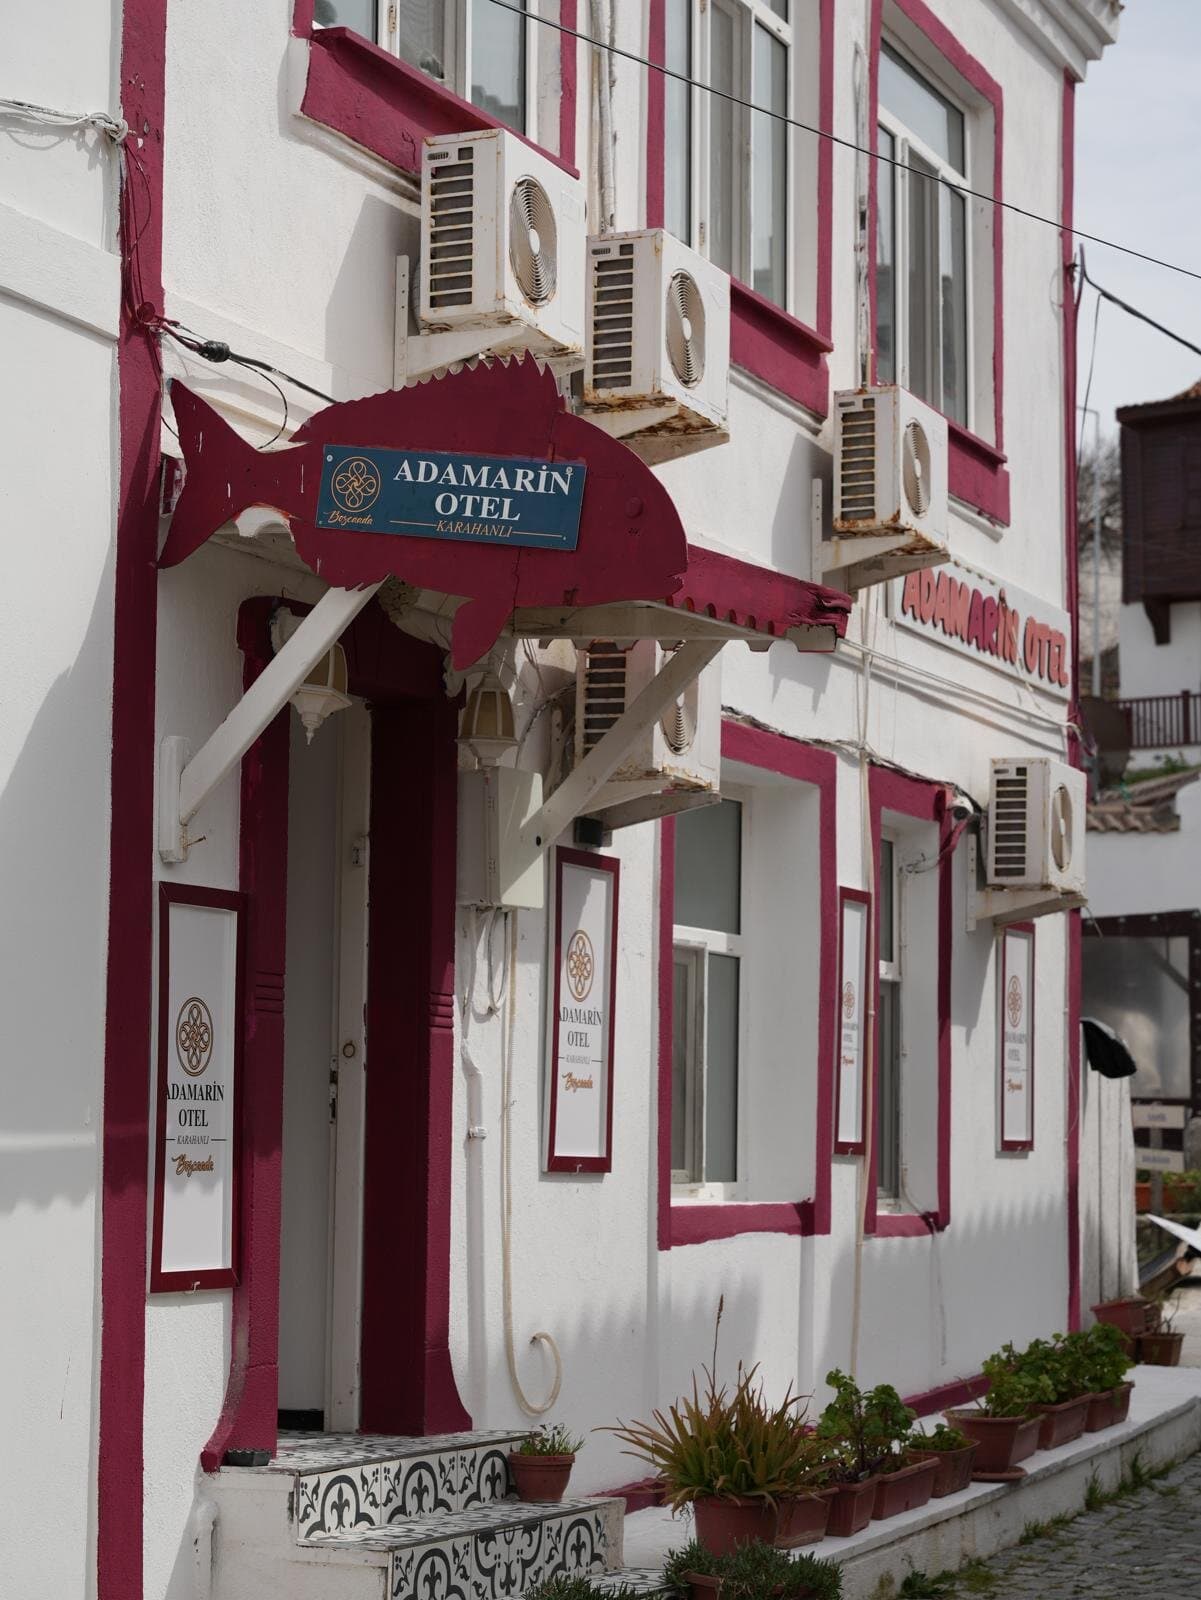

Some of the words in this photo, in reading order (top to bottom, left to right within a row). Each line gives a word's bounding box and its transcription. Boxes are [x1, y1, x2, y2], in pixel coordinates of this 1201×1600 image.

[393, 459, 574, 496] ADAMARİN
[434, 492, 520, 521] OTEL
[436, 520, 513, 538] KARAHANLI
[1024, 616, 1069, 688] OTEL
[567, 1031, 590, 1048] OTEL
[178, 1109, 209, 1127] OTEL
